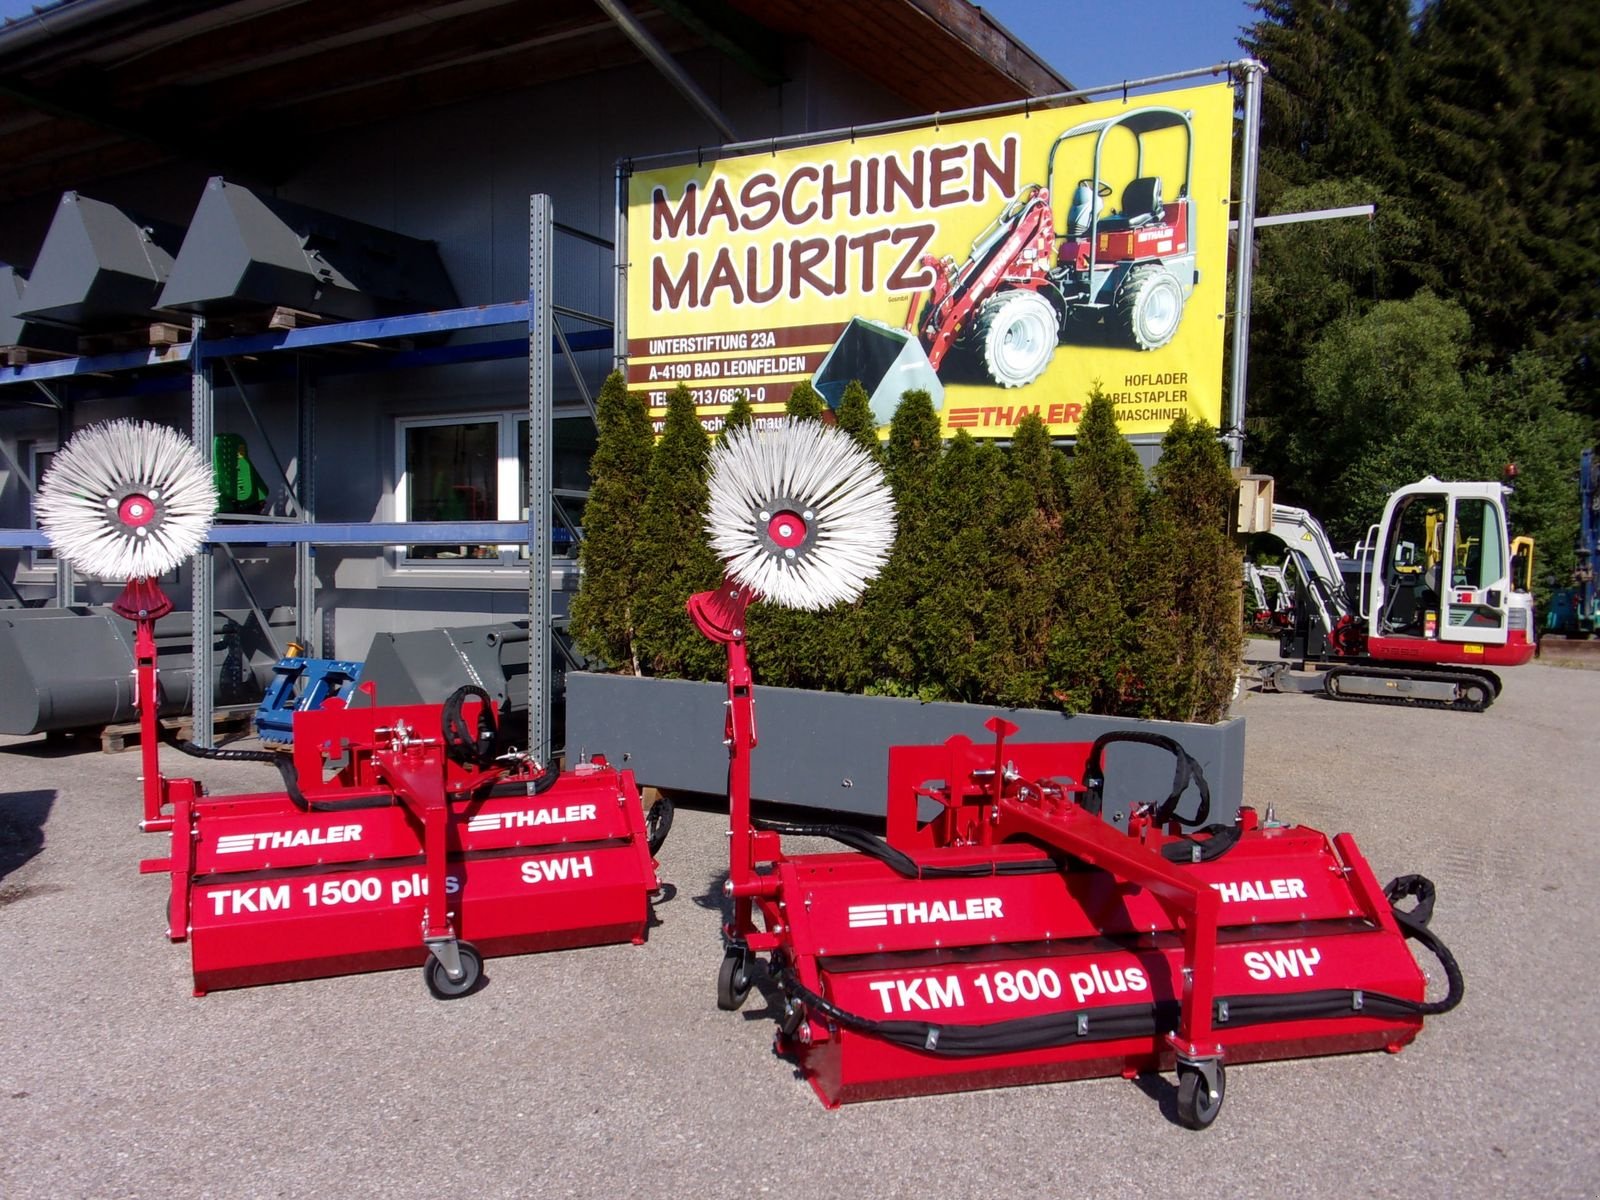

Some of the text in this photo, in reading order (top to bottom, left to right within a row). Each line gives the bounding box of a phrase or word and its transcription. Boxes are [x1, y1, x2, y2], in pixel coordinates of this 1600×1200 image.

[652, 137, 1018, 241] MASCHINEN
[652, 224, 936, 311] MAURITZ
[649, 331, 776, 355] UNTERSTIFTUNG 23A
[649, 356, 806, 381] A-4190 BAD LEONFELDEN
[1124, 372, 1188, 387] HOFLADER
[1103, 390, 1188, 405] ABELSTAPLER
[1114, 407, 1188, 422] MASCHINEN
[500, 804, 597, 829] THALER
[253, 824, 363, 850] THALER
[520, 855, 594, 884] SWH
[207, 884, 291, 915] TKM
[302, 876, 382, 907] 1500
[886, 897, 1004, 925] THALER
[869, 963, 1148, 1013] TKM 1800 plus
